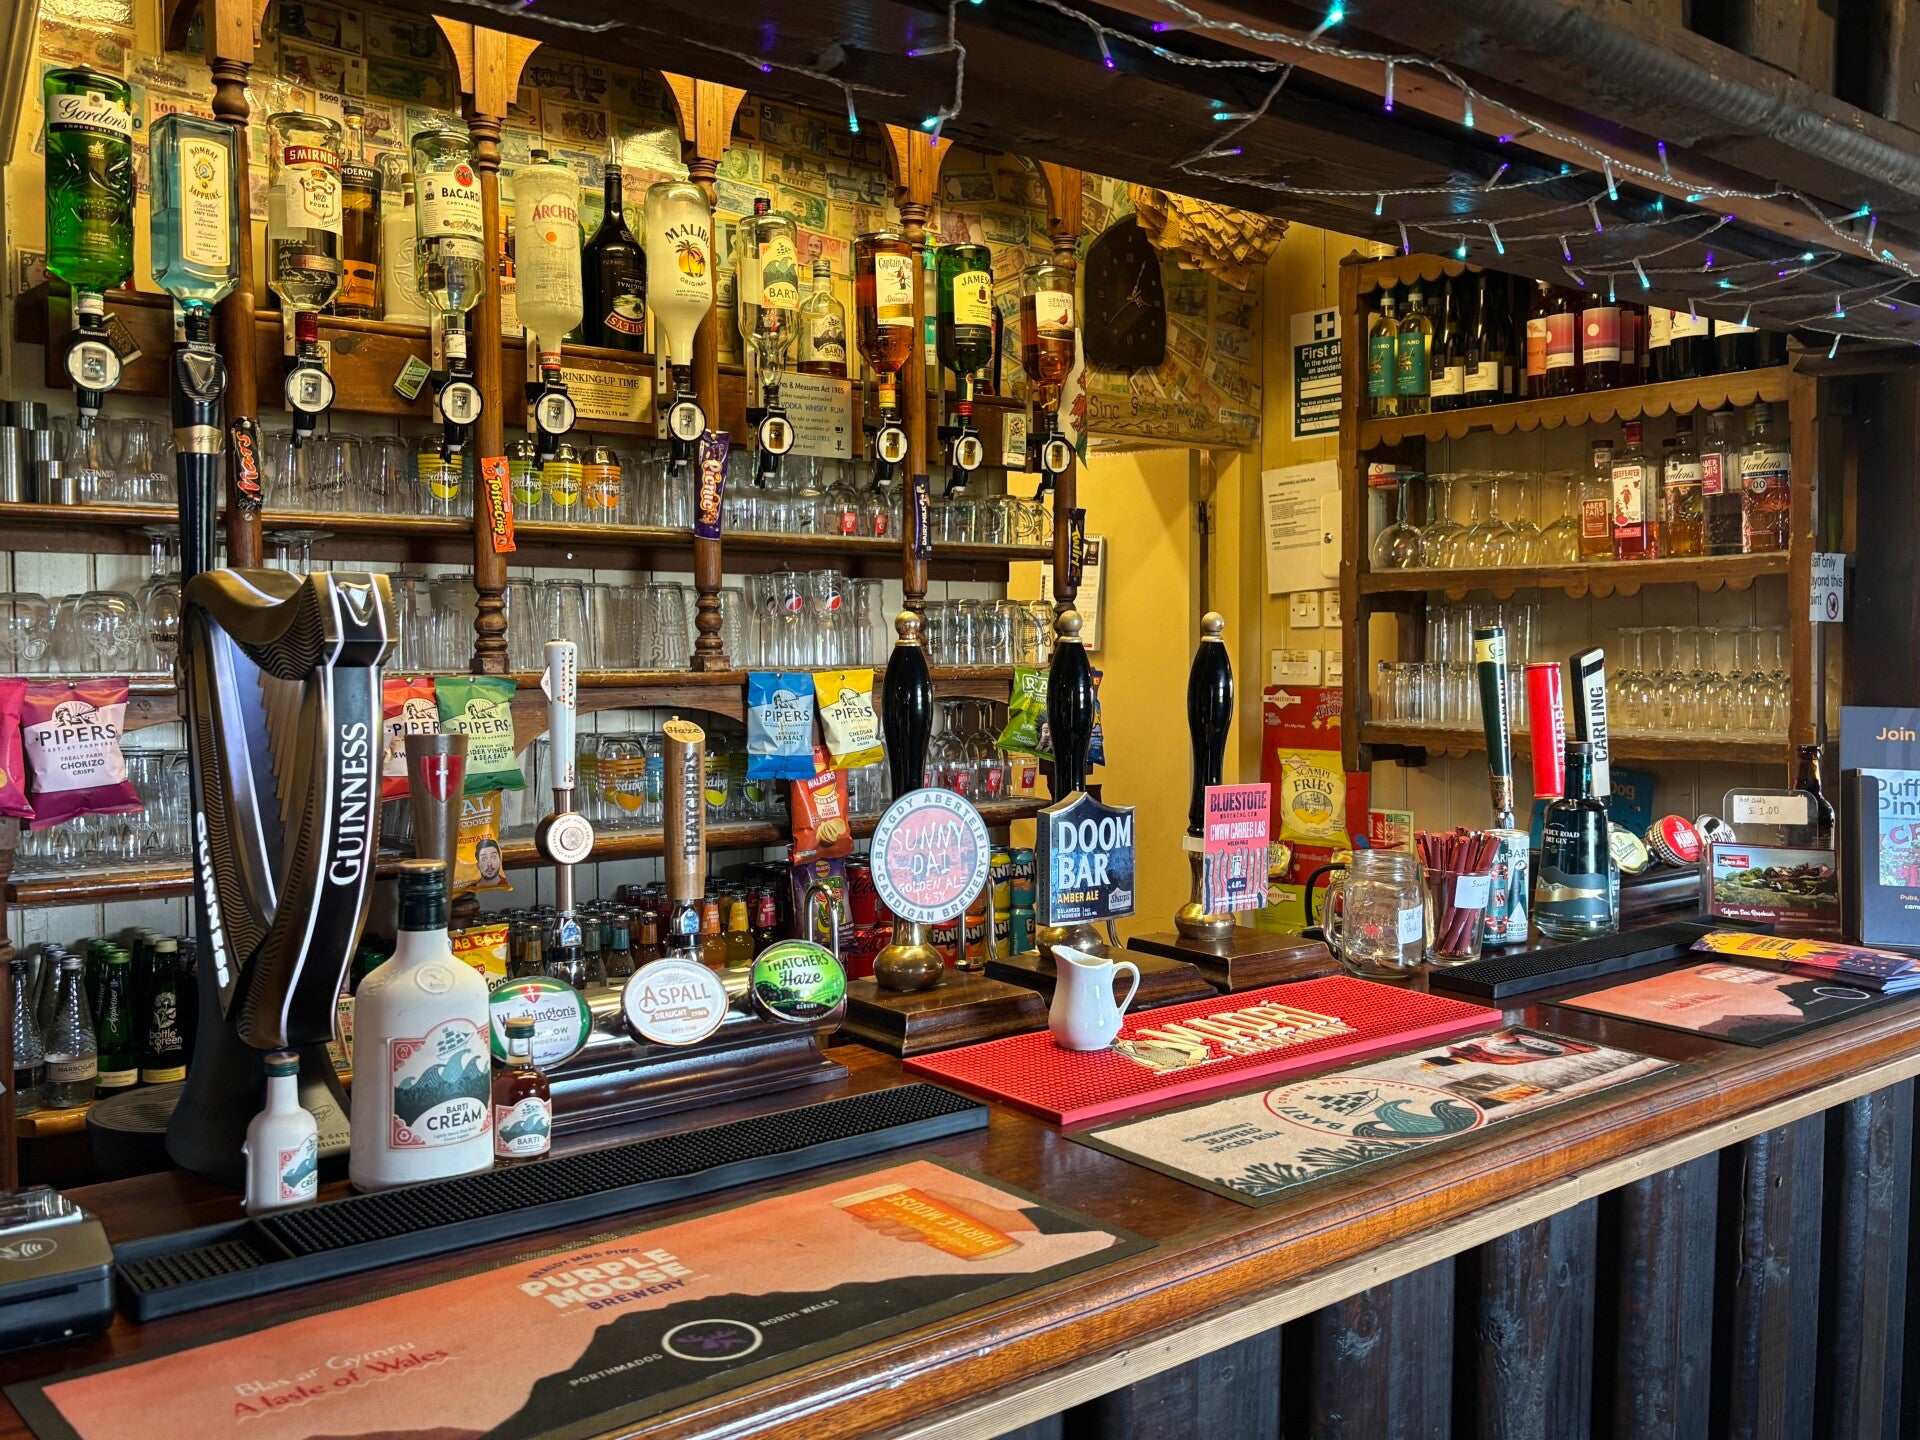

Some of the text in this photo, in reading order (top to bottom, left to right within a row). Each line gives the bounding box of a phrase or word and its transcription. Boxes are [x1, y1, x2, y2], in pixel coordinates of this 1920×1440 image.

[319, 92, 339, 102] 5000
[59, 98, 128, 131] Gordon's
[189, 146, 220, 161] BOMBAY
[289, 149, 340, 170] SMIRNOFF
[188, 186, 223, 200] SAPPHIRE
[441, 187, 482, 203] BACARD
[309, 201, 330, 209] VODKA
[533, 204, 578, 225] ARCHER
[680, 277, 706, 288] ORIGINAL
[961, 271, 991, 288] JAMES
[1302, 341, 1341, 361] First ai
[1304, 357, 1338, 368] In the event
[1316, 363, 1342, 374] accident
[561, 372, 639, 388] RINKING-UP TIME
[794, 383, 820, 393] Measures
[820, 384, 830, 393] Act
[805, 403, 827, 414] WHISKY
[831, 407, 845, 415] RUM
[235, 430, 261, 507] Mars
[1741, 458, 1780, 473] Gordon's
[1612, 469, 1640, 480] BEEFEATER
[1665, 470, 1695, 482] ordon's
[702, 459, 722, 511] Picnic
[488, 476, 506, 535] Toffee Crisp
[1585, 502, 1604, 511] ABER
[1071, 525, 1083, 567] Twirl
[1822, 557, 1836, 570] only
[1830, 574, 1844, 587] this
[765, 710, 810, 722] PIPERS
[835, 706, 873, 721] PIPERS
[392, 721, 442, 737] PIPER
[460, 719, 509, 734] PIPERS
[666, 725, 702, 735] Haze
[1590, 685, 1608, 763] CARLING
[39, 724, 117, 747] PIPERS
[789, 735, 804, 743] SALT
[848, 729, 873, 739] CHEDDAR
[856, 735, 874, 745] ONION
[1876, 726, 1916, 742] Join
[79, 741, 114, 750] FARMERS
[60, 759, 105, 770] CHORIZO
[492, 752, 508, 760] SALT
[72, 768, 95, 776] CRISPS
[808, 771, 837, 789] WALKERS
[1296, 766, 1331, 779] SCAMPI
[1293, 778, 1335, 796] FRIES
[329, 721, 370, 887] GUINNESS
[683, 750, 701, 862] THATCHERS
[1210, 790, 1267, 813] BLUESTONE
[875, 798, 915, 860] BRAGDY
[924, 792, 989, 852] ABERTEIFI
[1254, 820, 1266, 837] LAS
[892, 819, 967, 854] SUNNY
[1057, 815, 1132, 854] DOOM
[1556, 837, 1568, 845] GIN
[1560, 831, 1579, 839] ROAD
[913, 849, 951, 876] DAI
[1011, 863, 1037, 877] FANT
[1057, 852, 1111, 890] BAR
[899, 876, 969, 894] GOLDEN ALE
[941, 860, 989, 920] BREWERY
[876, 866, 937, 924] CARDIGAN
[1057, 890, 1100, 905] AMBER ALE
[931, 929, 958, 943] FANT
[764, 953, 830, 973] THATCHERS
[778, 970, 824, 987] Haze
[639, 984, 712, 1015] ASPALL
[497, 1004, 577, 1030] Wthington's
[653, 1008, 688, 1021] DRAUGHT
[149, 1028, 176, 1040] bottle
[557, 1035, 570, 1043] ALE
[154, 1036, 183, 1054] green
[446, 1102, 468, 1115] BARTI
[427, 1107, 483, 1132] CREAM
[1274, 1104, 1345, 1136] BARTI
[517, 1136, 541, 1146] BARTI
[1202, 1127, 1263, 1150] SEAWEED
[1207, 1131, 1285, 1158] SPICED RUM
[301, 1178, 317, 1188] CREA
[883, 1193, 1004, 1249] PURPLE MOOSE
[518, 1248, 679, 1298] PURPLE
[544, 1261, 695, 1310] MOOSE
[586, 1279, 687, 1311] BREWERY
[759, 1298, 840, 1329] NORTH WALES
[569, 1353, 664, 1387] PORTHMADOG
[233, 1348, 451, 1424] A Taste of Wales
[233, 1377, 291, 1407] Blas
[297, 1367, 321, 1386] ar
